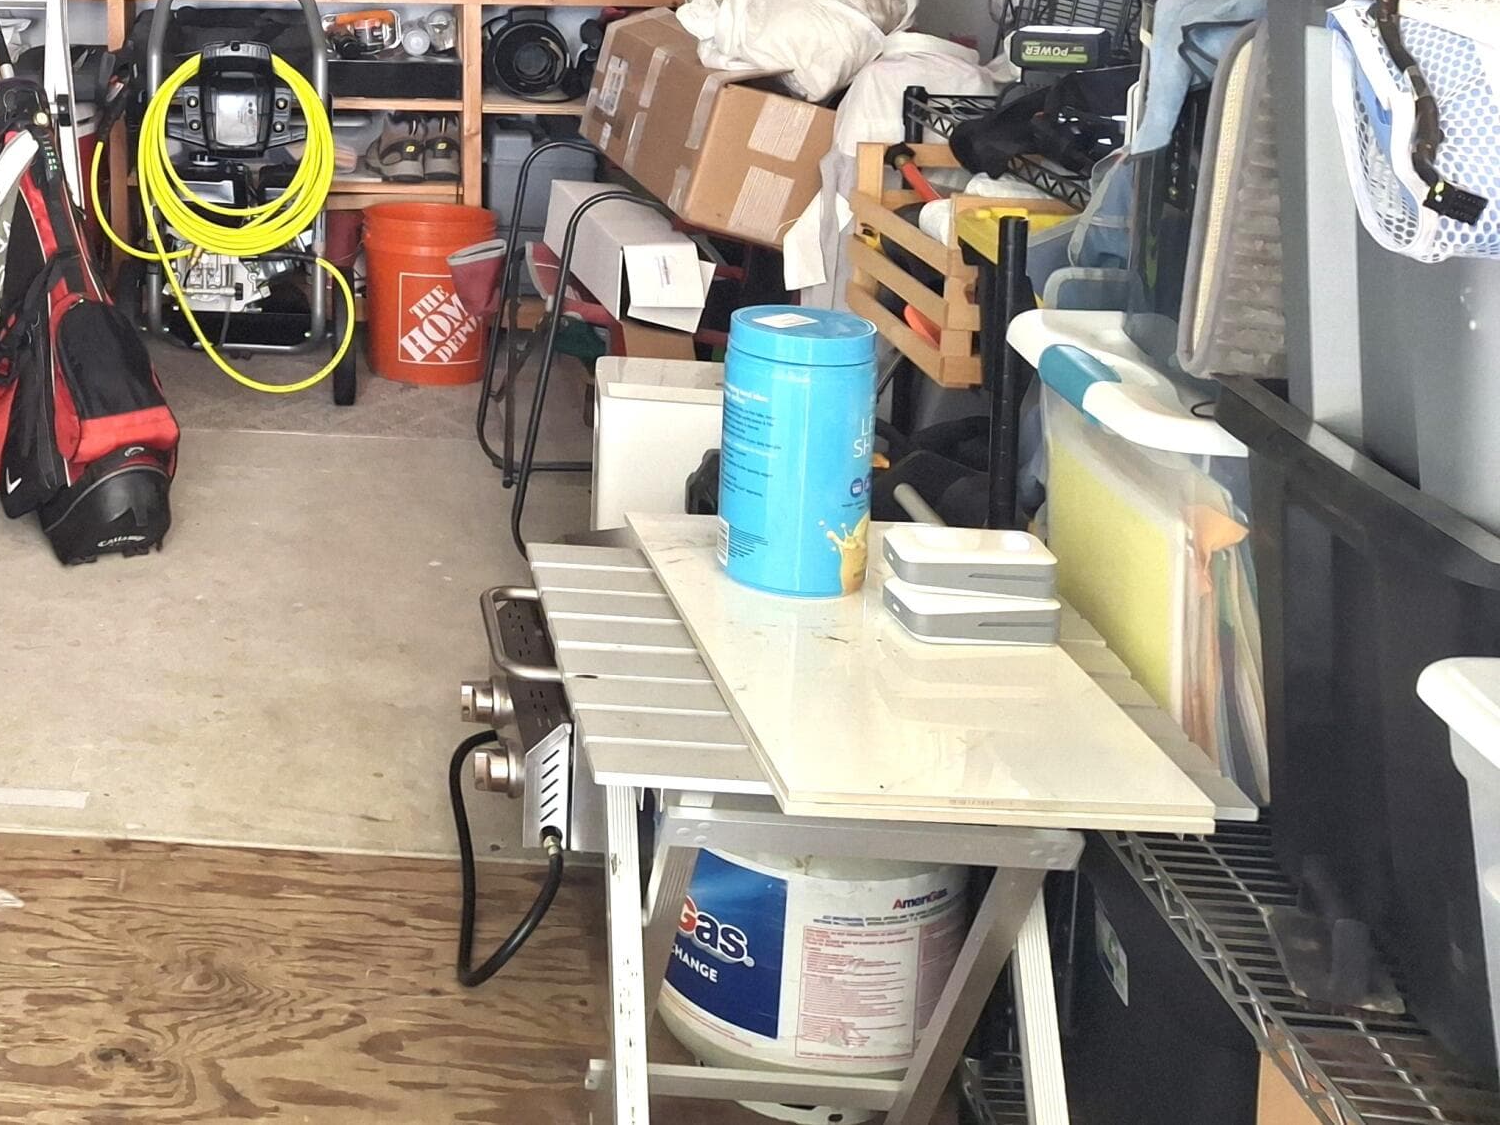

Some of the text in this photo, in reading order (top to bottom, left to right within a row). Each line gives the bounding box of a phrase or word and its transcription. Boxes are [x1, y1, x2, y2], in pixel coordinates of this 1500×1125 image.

[1024, 45, 1069, 57] POWER
[408, 284, 450, 320] THE
[400, 293, 469, 362] HOM
